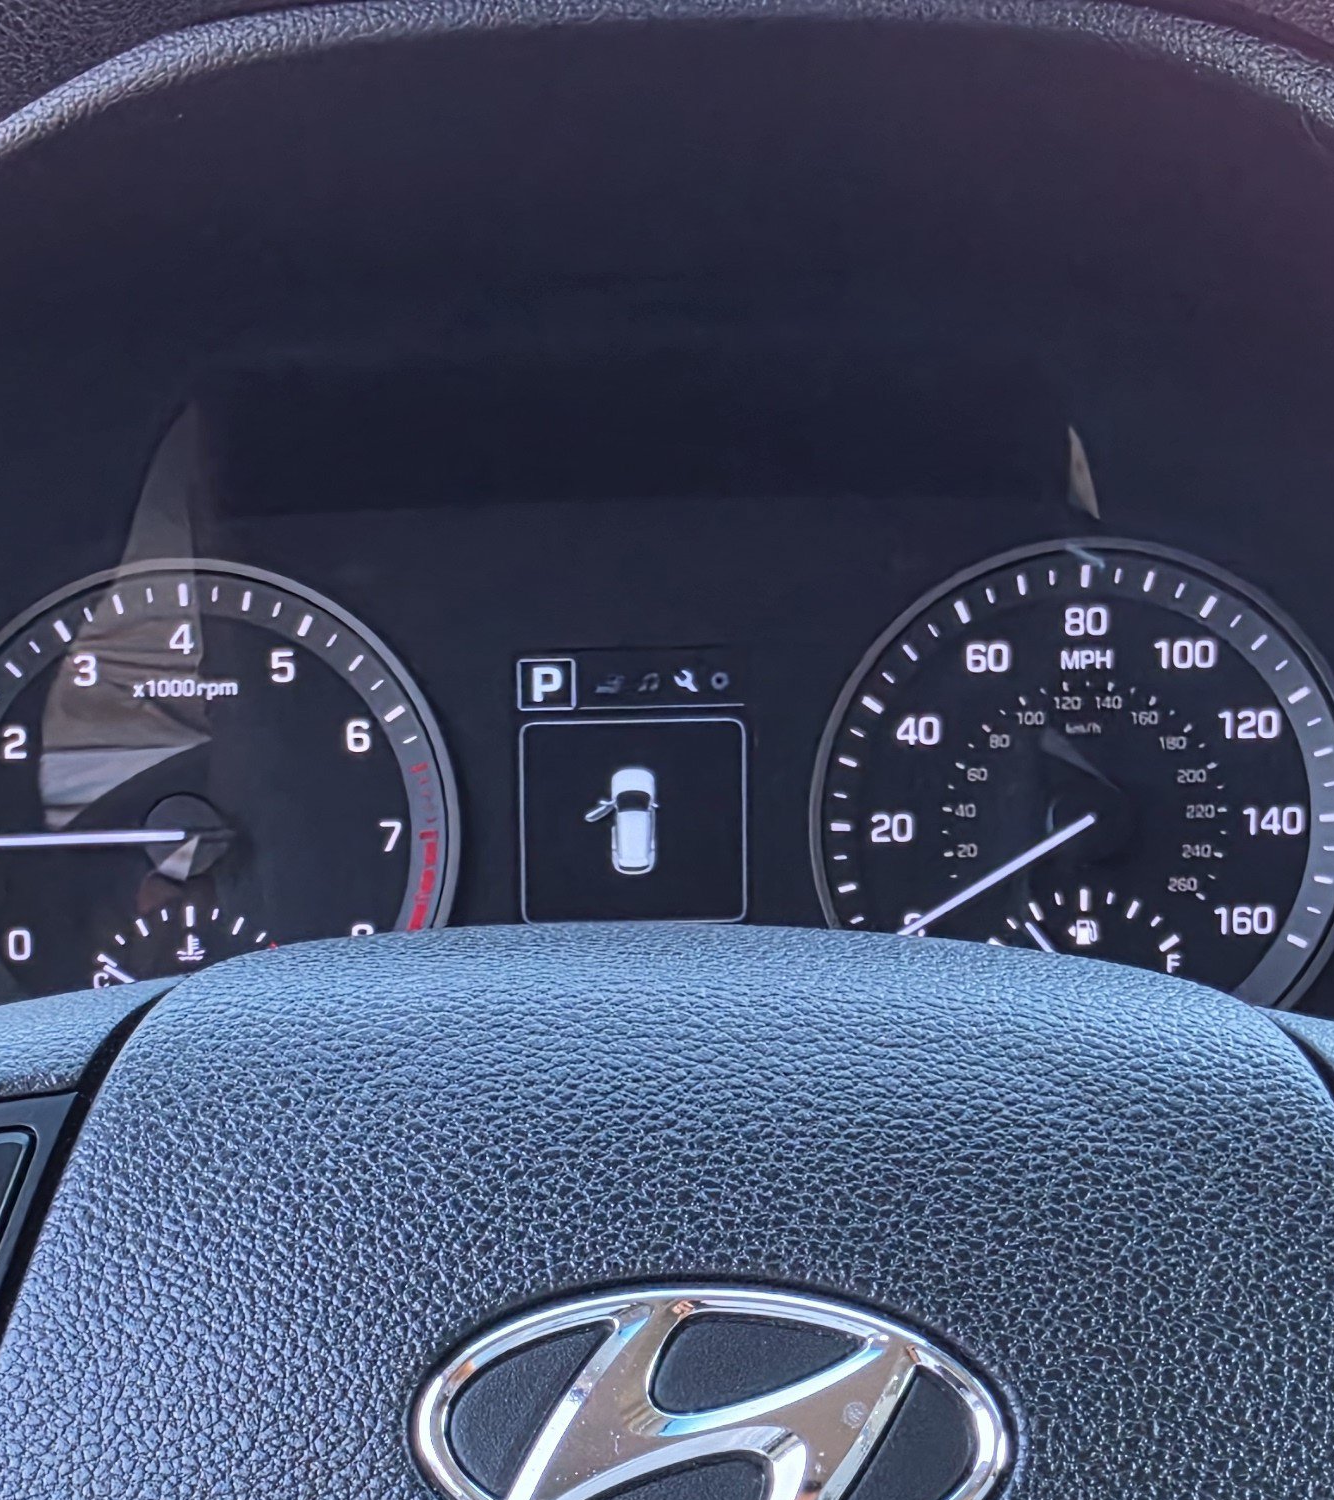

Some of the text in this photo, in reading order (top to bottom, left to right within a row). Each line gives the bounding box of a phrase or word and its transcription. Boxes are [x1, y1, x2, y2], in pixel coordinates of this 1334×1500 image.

[1064, 607, 1108, 636] 80
[170, 624, 193, 654] 4
[271, 651, 295, 683] 5
[966, 643, 1009, 673] 60
[1060, 650, 1112, 671] MPH
[1154, 639, 1216, 669] 100
[74, 656, 97, 686] 3
[533, 667, 563, 702] P
[1054, 696, 1081, 710] 120
[1096, 696, 1122, 709] 140
[895, 716, 941, 746] 40
[1017, 711, 1044, 726] 100
[1131, 711, 1159, 725] 160
[1218, 710, 1279, 739] 120
[4, 728, 27, 760] 2
[346, 721, 370, 752] 6
[989, 734, 1010, 748] 80
[1160, 736, 1187, 750] 180
[967, 768, 988, 782] 60
[1177, 769, 1206, 783] 200
[955, 804, 976, 818] 40
[1186, 804, 1216, 818] 220
[1243, 806, 1303, 836] 140
[380, 821, 401, 852] 7
[870, 813, 913, 843] 20
[957, 843, 977, 858] 20
[1182, 844, 1212, 858] 240
[1168, 877, 1198, 892] 260
[1214, 907, 1274, 936] 160
[8, 929, 31, 960] 0
[1166, 953, 1181, 973] F
